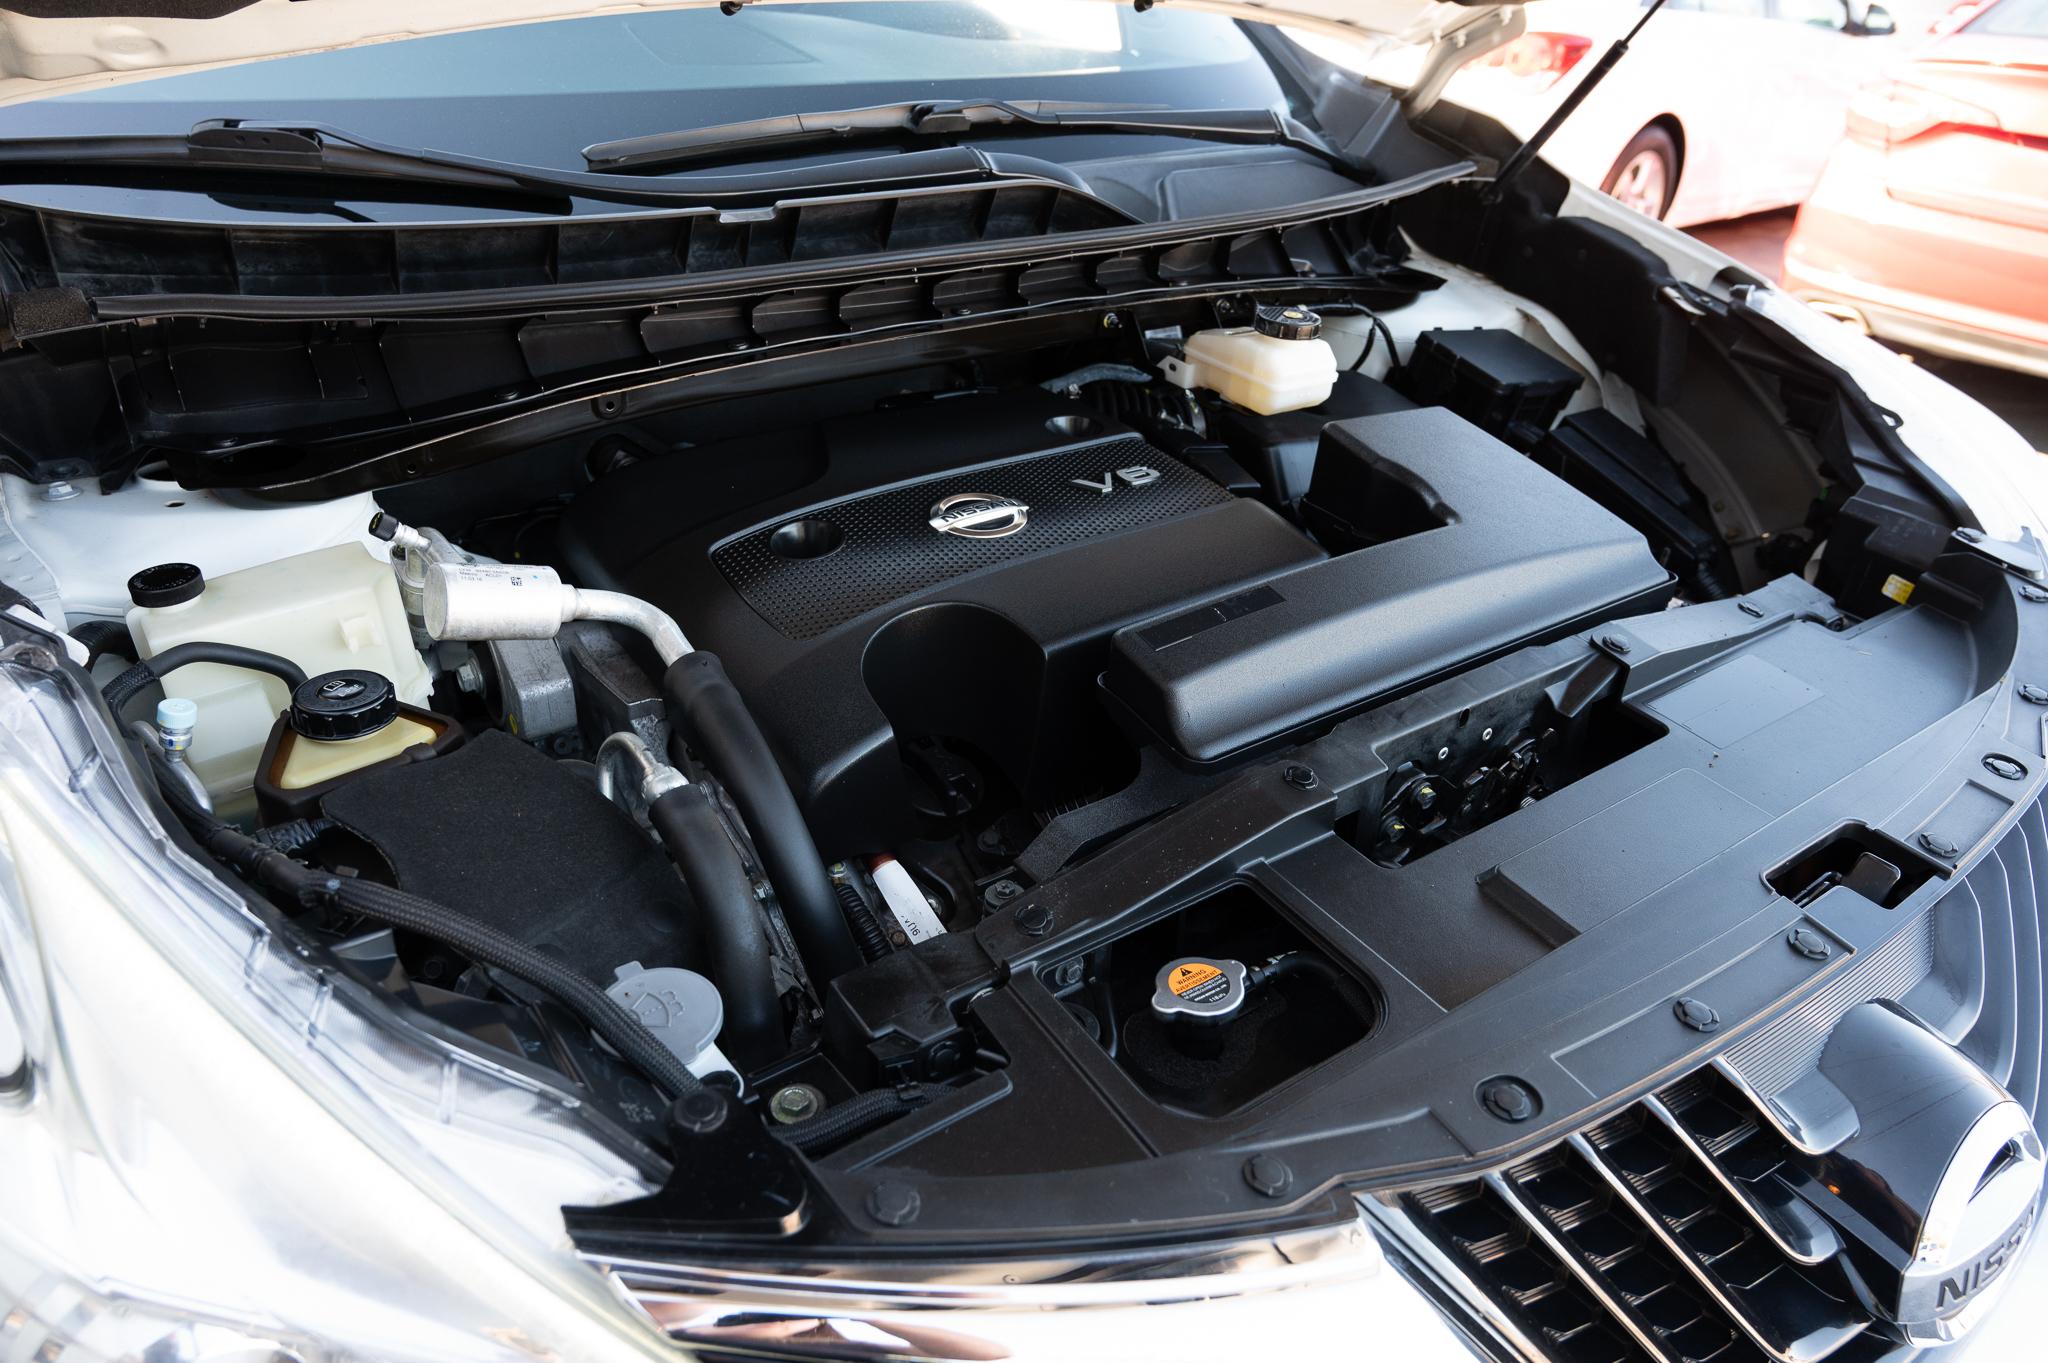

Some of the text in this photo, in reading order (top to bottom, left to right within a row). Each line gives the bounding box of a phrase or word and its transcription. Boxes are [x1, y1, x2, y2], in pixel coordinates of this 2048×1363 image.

[1071, 466, 1160, 493] V6
[940, 499, 1018, 522] NISSAN
[1177, 969, 1207, 985] WARNING
[1935, 1206, 2034, 1311] NISS
